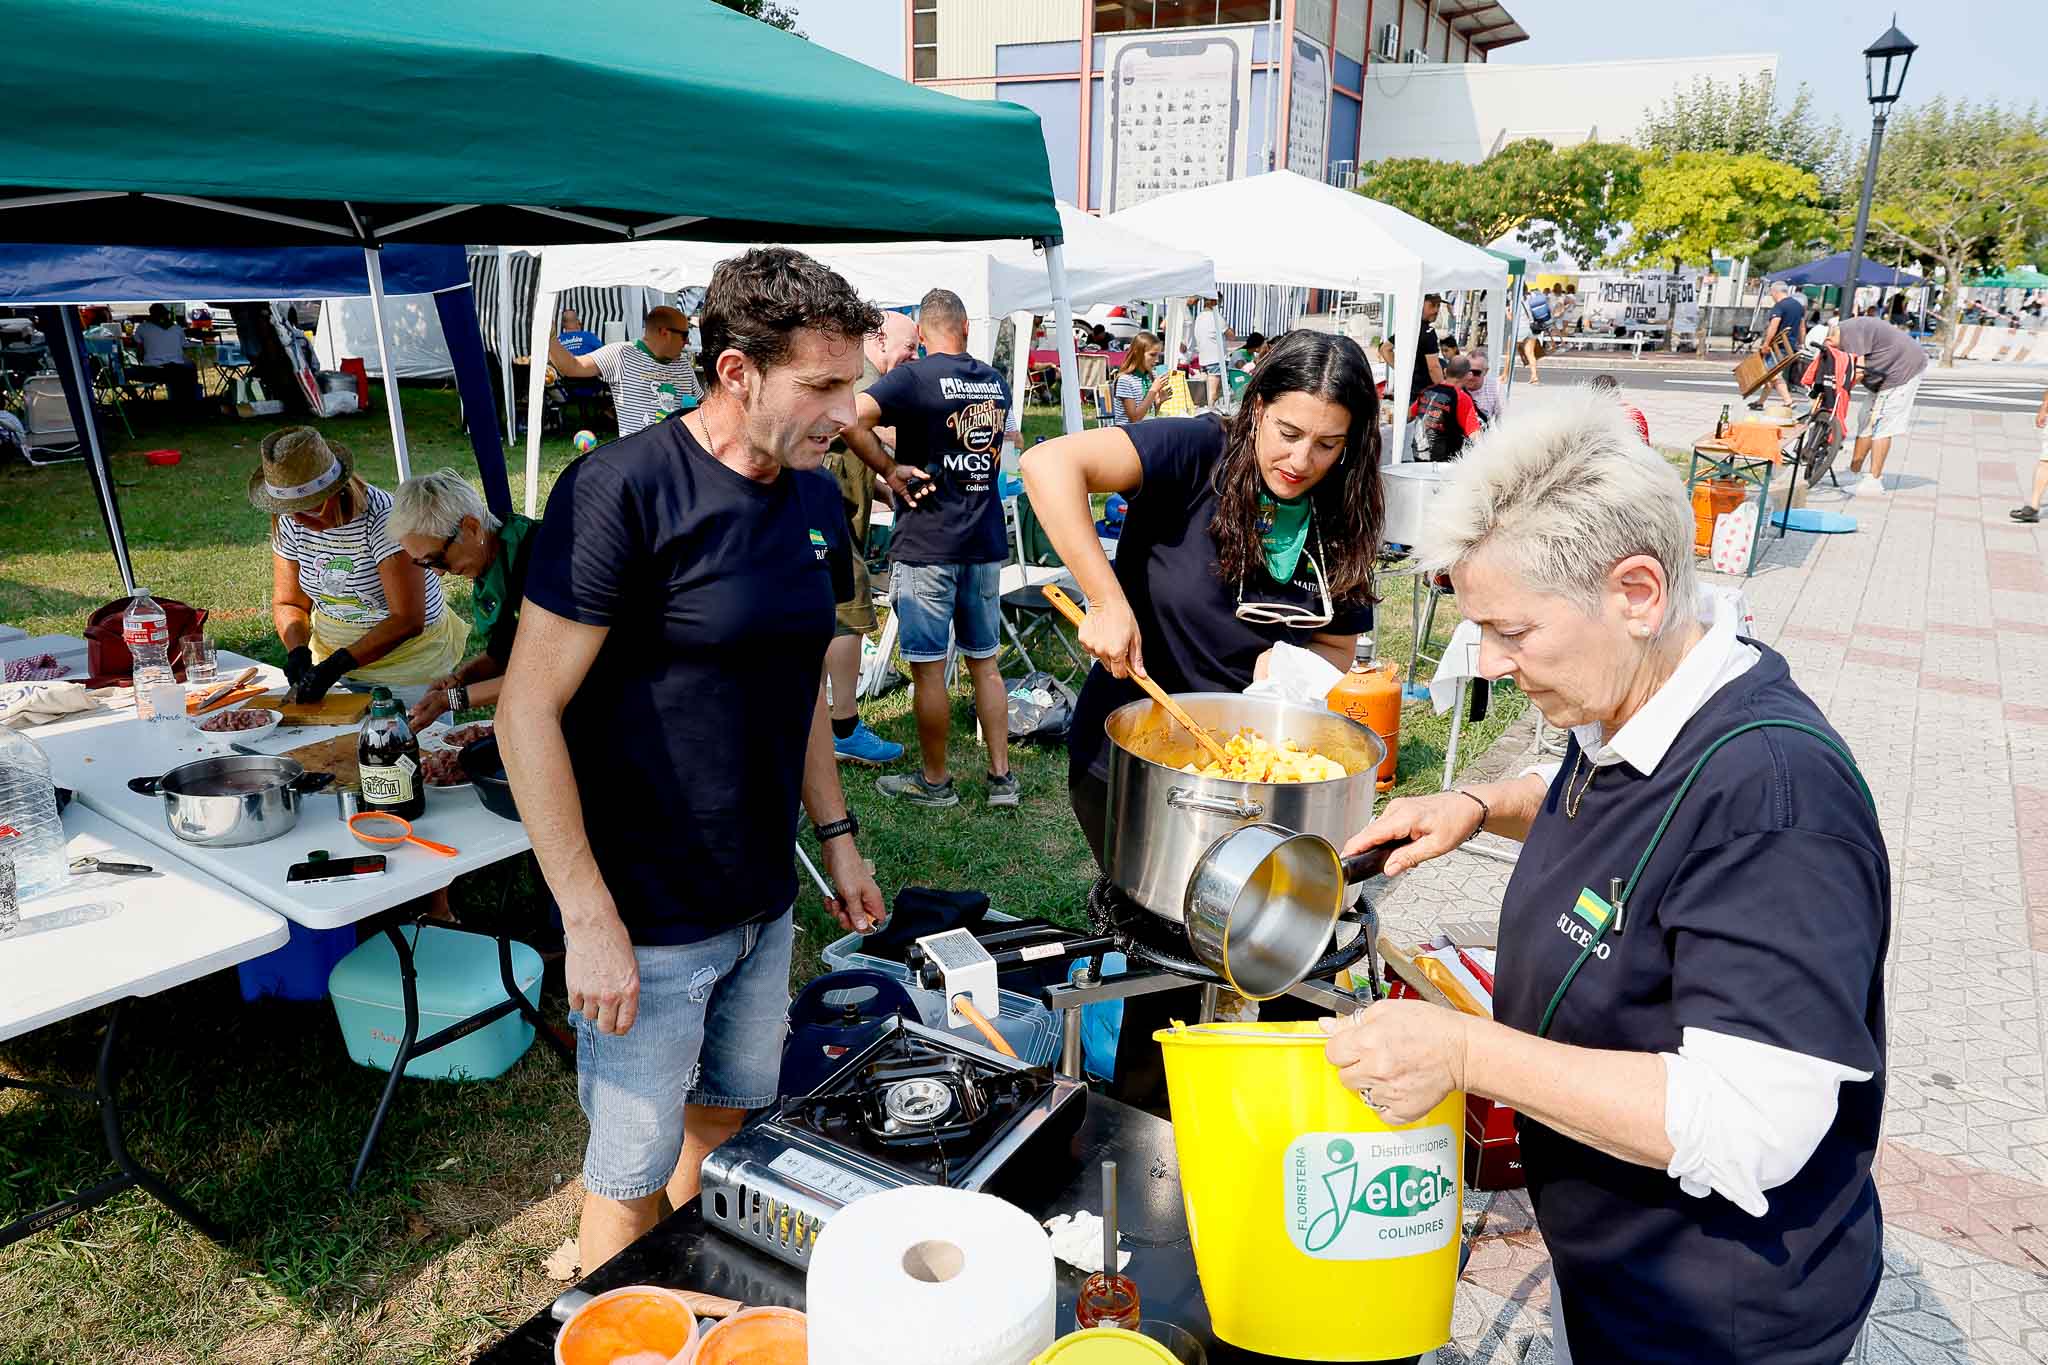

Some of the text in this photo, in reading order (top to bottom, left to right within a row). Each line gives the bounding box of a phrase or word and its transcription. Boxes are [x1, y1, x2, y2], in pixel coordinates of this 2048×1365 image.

[1599, 281, 1648, 304] HOSPITAL
[1625, 306, 1656, 319] DIGNO
[944, 453, 991, 471] MGS
[1371, 1137, 1449, 1158] Distribuciones
[1295, 1146, 1308, 1231] FLORISTERIA
[1378, 1218, 1444, 1240] COLINDRES
